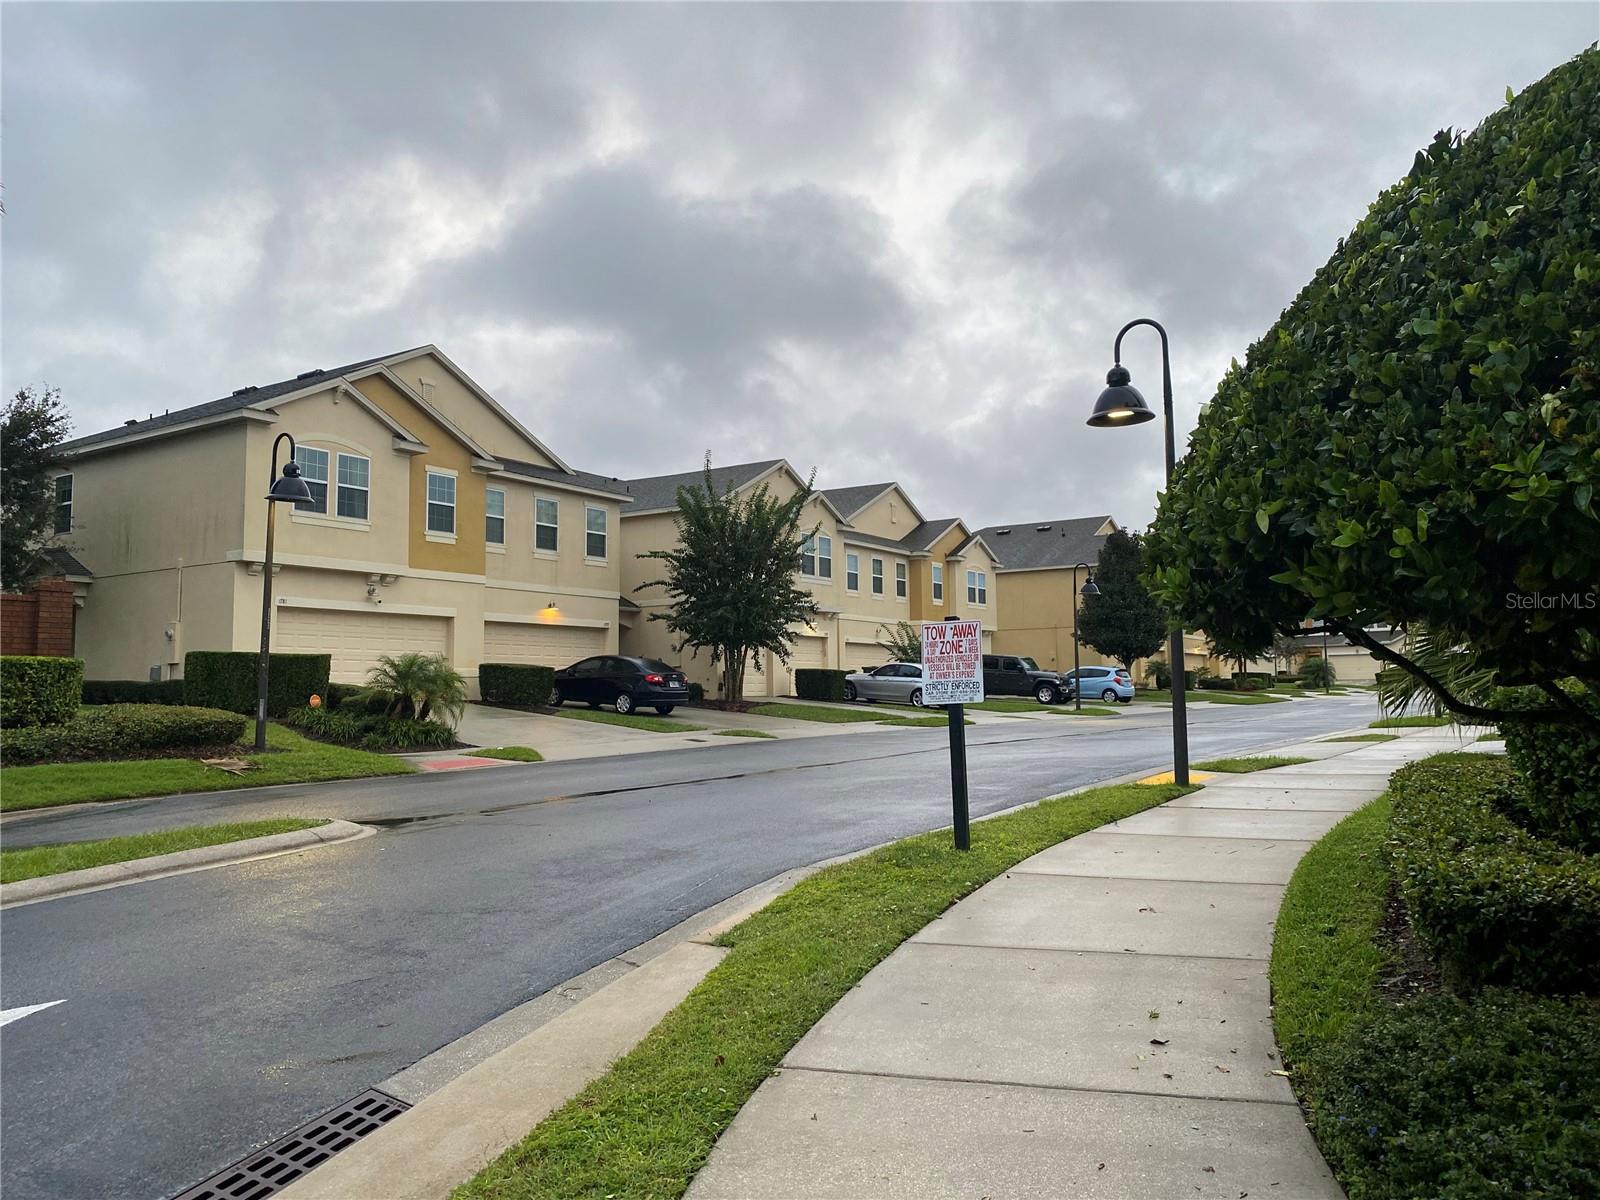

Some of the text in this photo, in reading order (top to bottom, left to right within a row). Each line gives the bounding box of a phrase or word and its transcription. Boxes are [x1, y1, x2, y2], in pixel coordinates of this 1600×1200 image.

[924, 624, 978, 640] TOW AWAY
[939, 639, 963, 655] ZONE
[968, 646, 979, 654] WEEK
[925, 653, 979, 664] UNAUTHORIZED VEHICLES OR
[928, 661, 976, 672] VESSELS WILL BE TOWED
[929, 670, 975, 679] AT OWNER'S EXPENSE
[925, 682, 980, 691] STRICTLY ENFORCED
